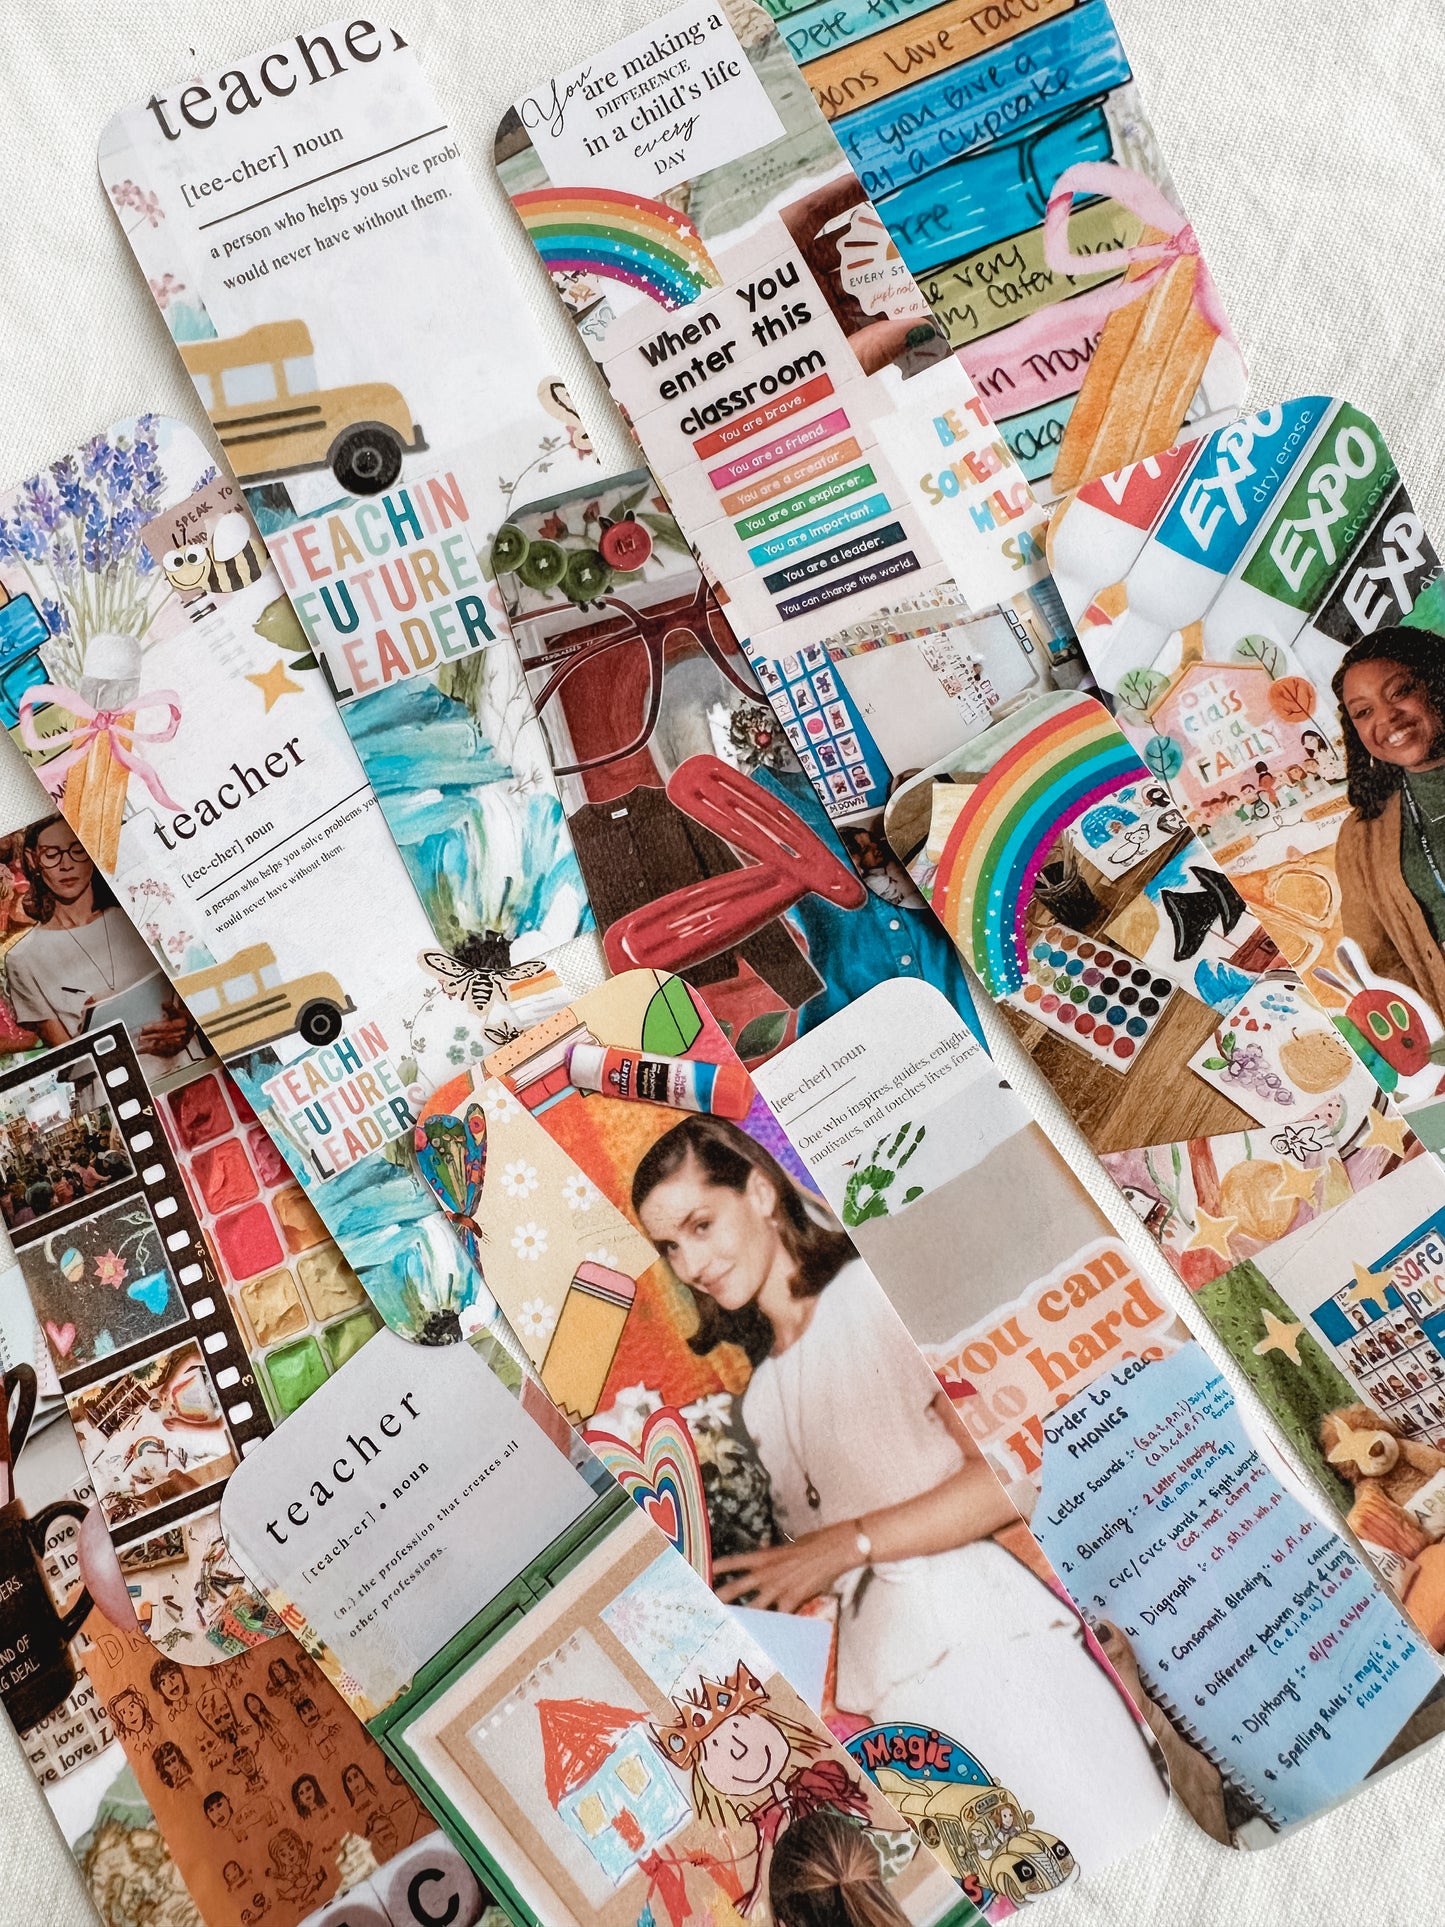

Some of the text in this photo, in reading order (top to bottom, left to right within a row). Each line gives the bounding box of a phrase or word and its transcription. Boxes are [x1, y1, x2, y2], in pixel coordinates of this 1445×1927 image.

[785, 9, 854, 59] Pete
[883, 30, 954, 75] Love
[521, 13, 723, 138] You are making a
[596, 59, 691, 119] DIFFERENCE
[876, 105, 937, 150] you
[1015, 52, 1038, 75] a
[583, 59, 741, 157] in a child's life
[635, 115, 700, 158] every
[180, 127, 344, 208] [tee-cher] noun
[654, 149, 687, 175] DAY
[908, 149, 930, 174] a
[210, 246, 220, 259] a
[222, 225, 272, 258] person
[274, 209, 306, 233] who
[308, 194, 348, 220] helps
[349, 182, 379, 205] you
[382, 164, 420, 194] solve
[223, 190, 452, 290] would never have without them.
[953, 244, 1027, 287] very
[639, 261, 800, 367] When you
[659, 302, 812, 400] enter this
[680, 349, 826, 435] classroom
[720, 396, 806, 443] You are brave.
[729, 424, 828, 476] You are a friend.
[933, 409, 969, 447] BE
[737, 453, 845, 505] You are a creator.
[745, 475, 865, 532] You are an explorer.
[1179, 406, 1284, 551] EXPO
[1252, 467, 1281, 503] dry
[1276, 410, 1314, 463] erase
[175, 502, 213, 530] SPEAK
[266, 472, 470, 590] TEACHIN
[1269, 426, 1377, 593] EXPO
[1343, 503, 1368, 544] dry
[764, 542, 784, 556] You
[787, 533, 807, 546] are
[783, 538, 885, 583] You are a leader.
[293, 535, 478, 647] FUTURE
[783, 559, 914, 615] You can change the world.
[1196, 726, 1282, 783] FAMILY
[1229, 720, 1245, 737] a
[153, 737, 306, 850] teacher
[181, 821, 275, 888] [tee-cher] noun
[205, 907, 211, 917] a
[212, 889, 241, 914] person
[241, 876, 260, 894] who
[260, 860, 283, 878] helps
[283, 850, 300, 866] you
[300, 834, 323, 852] solve
[324, 807, 363, 841] problems
[215, 844, 346, 933] would never have without them.
[265, 1021, 389, 1113] TEACHIN
[831, 1043, 867, 1070] noun
[289, 1059, 399, 1146] FUTURE
[799, 1130, 822, 1149] One
[823, 1114, 848, 1130] who
[848, 1080, 894, 1115] inspires,
[893, 1059, 930, 1088] guides,
[810, 1065, 952, 1165] motivates, and touches lives
[1395, 1242, 1443, 1287] safe
[933, 1250, 1131, 1379] you can
[964, 1385, 1028, 1440] do
[1026, 1278, 1164, 1392] hard
[1043, 1389, 1111, 1444] Order to
[1067, 1406, 1128, 1459] PHONICS
[266, 1391, 420, 1544] teacher
[1177, 1440, 1216, 1473] blending
[358, 1577, 376, 1598] the
[379, 1522, 435, 1580] profession
[437, 1498, 460, 1521] that
[463, 1459, 501, 1497] creates
[504, 1440, 519, 1458] all
[1048, 1458, 1125, 1526] Letter Sounds
[1226, 1483, 1249, 1506] camp
[302, 1462, 429, 1584] [teach-er] noun
[1167, 1509, 1199, 1541] words
[350, 1608, 379, 1638] other
[382, 1546, 448, 1610] professions.
[1140, 1574, 1197, 1625] Diagraphs
[1171, 1570, 1273, 1661] Consonant Blending
[17, 1634, 30, 1651] OF
[1205, 1643, 1257, 1697] Difference
[1256, 1606, 1295, 1645] between
[53, 1722, 84, 1748] love
[863, 1729, 953, 1771] Magic
[1278, 1721, 1331, 1769] Spelling
[408, 1868, 460, 1920] C
